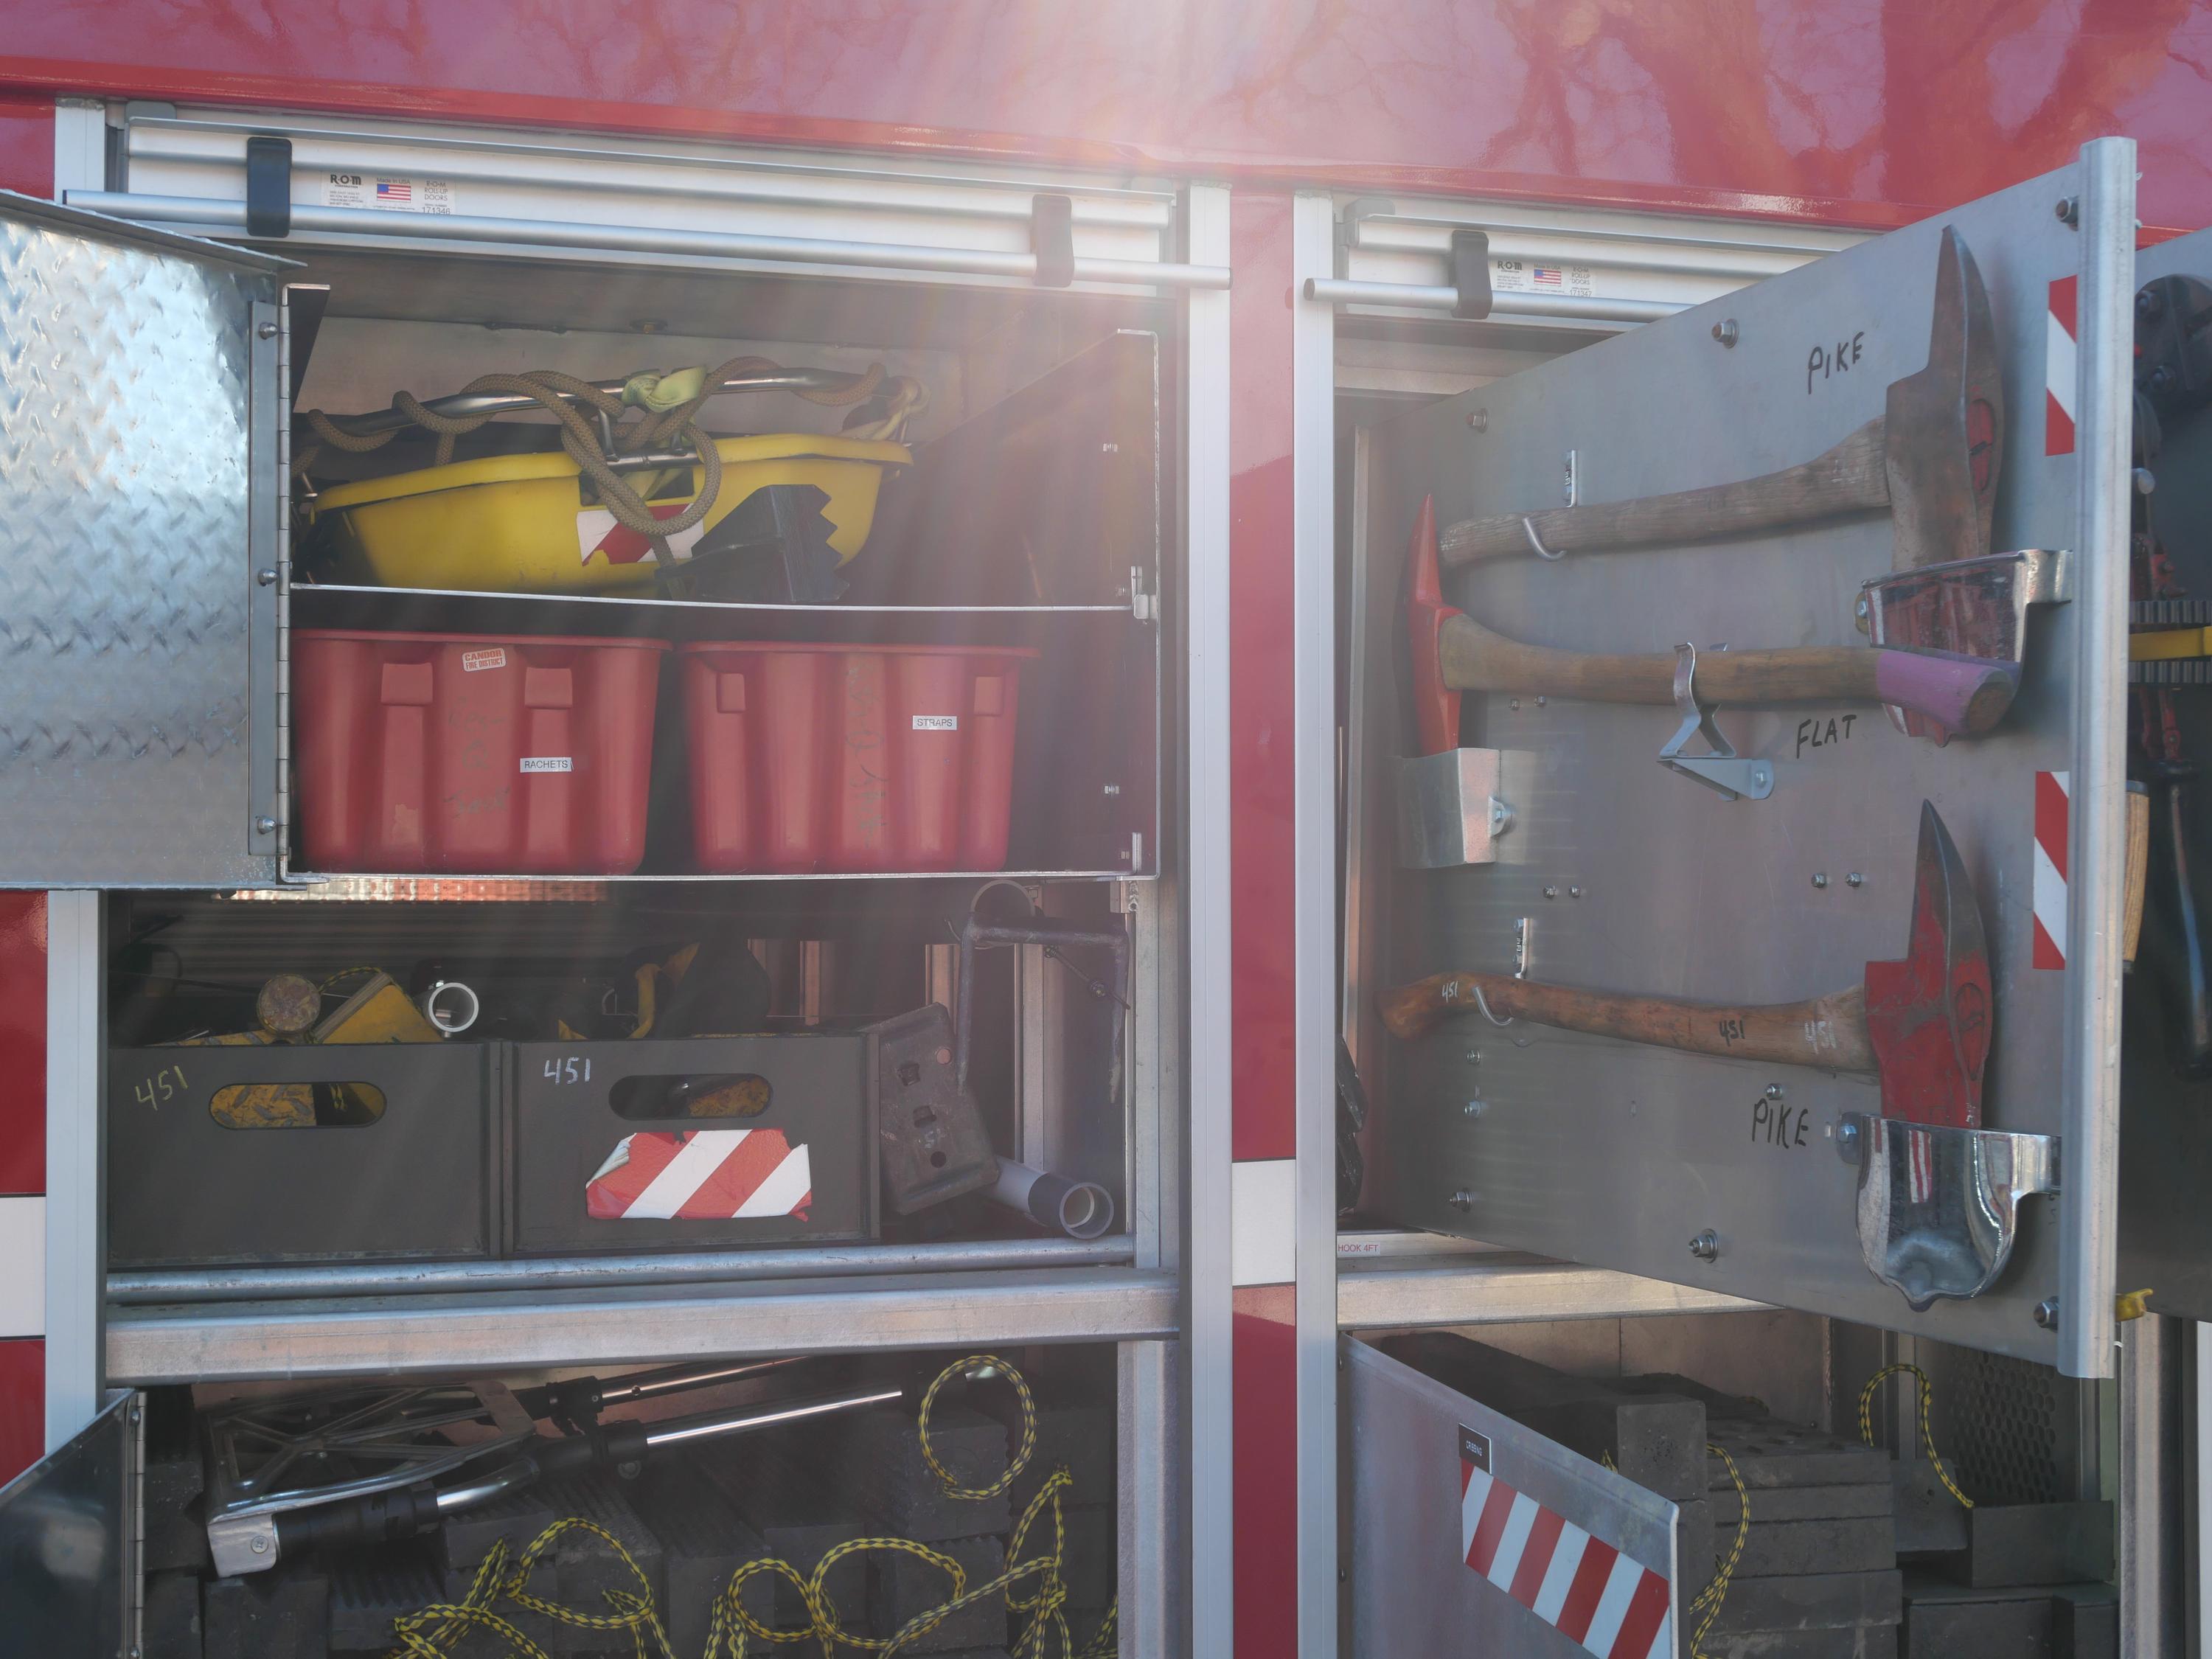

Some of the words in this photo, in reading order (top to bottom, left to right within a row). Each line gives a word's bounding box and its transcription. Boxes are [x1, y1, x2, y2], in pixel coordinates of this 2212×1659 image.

[1808, 331, 1865, 395] PIKE
[465, 650, 502, 662] CANDOR
[465, 661, 479, 671] FIRE
[479, 657, 503, 668] DISTRICT
[917, 718, 953, 727] STRAPS
[1796, 714, 1857, 759] FLAT
[524, 759, 568, 769] RACHETS
[1441, 981, 1458, 1004] 451
[1719, 1020, 1746, 1047] 451
[1804, 1020, 1836, 1055] 451
[543, 1057, 591, 1085] 451
[135, 1065, 189, 1111] 451
[1751, 1098, 1809, 1150] PIKE
[1338, 1244, 1362, 1252] HOOK
[1363, 1244, 1379, 1252] 4FT
